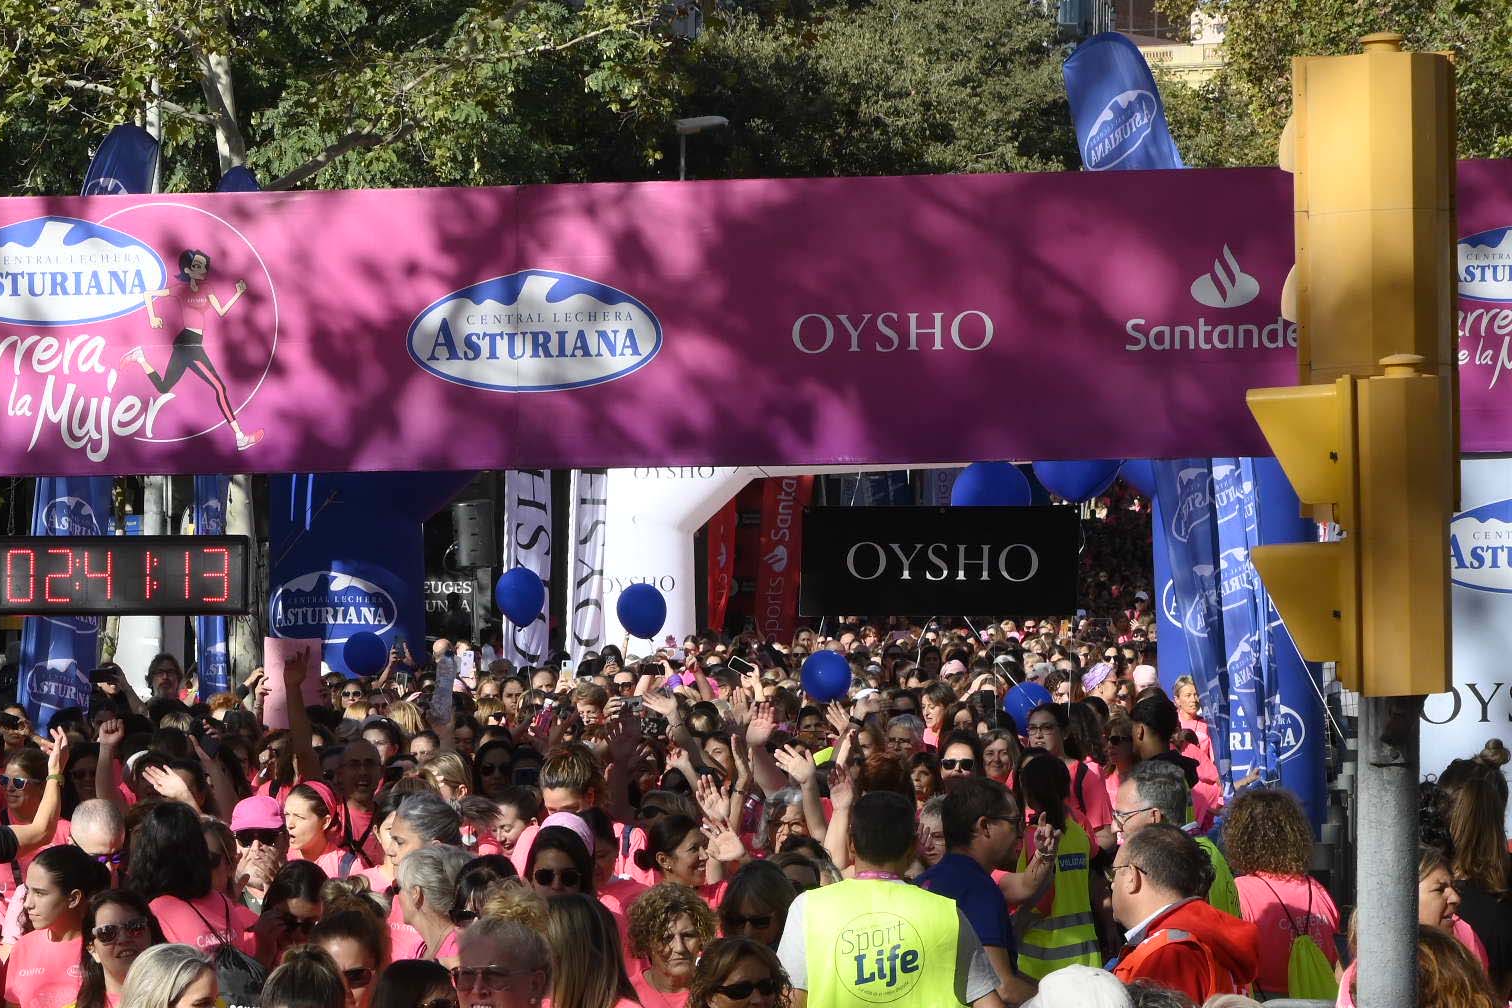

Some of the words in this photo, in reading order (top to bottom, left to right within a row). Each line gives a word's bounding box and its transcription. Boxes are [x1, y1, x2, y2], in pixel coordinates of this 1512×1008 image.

[69, 253, 143, 264] LECHERA
[466, 312, 545, 325] CENTRAL
[552, 310, 635, 323] LECHERA
[791, 310, 995, 354] OYSHO
[1126, 317, 1298, 351] Santande
[427, 317, 643, 361] ASTURIANA
[7, 377, 33, 417] la
[29, 368, 176, 463] Mujer
[772, 477, 797, 541] Santa
[7, 549, 228, 602] 02:41:13
[847, 541, 1040, 581] OYSHO
[275, 600, 388, 628] ASTURIANA
[841, 920, 905, 956] Sport
[854, 944, 920, 988] Life
